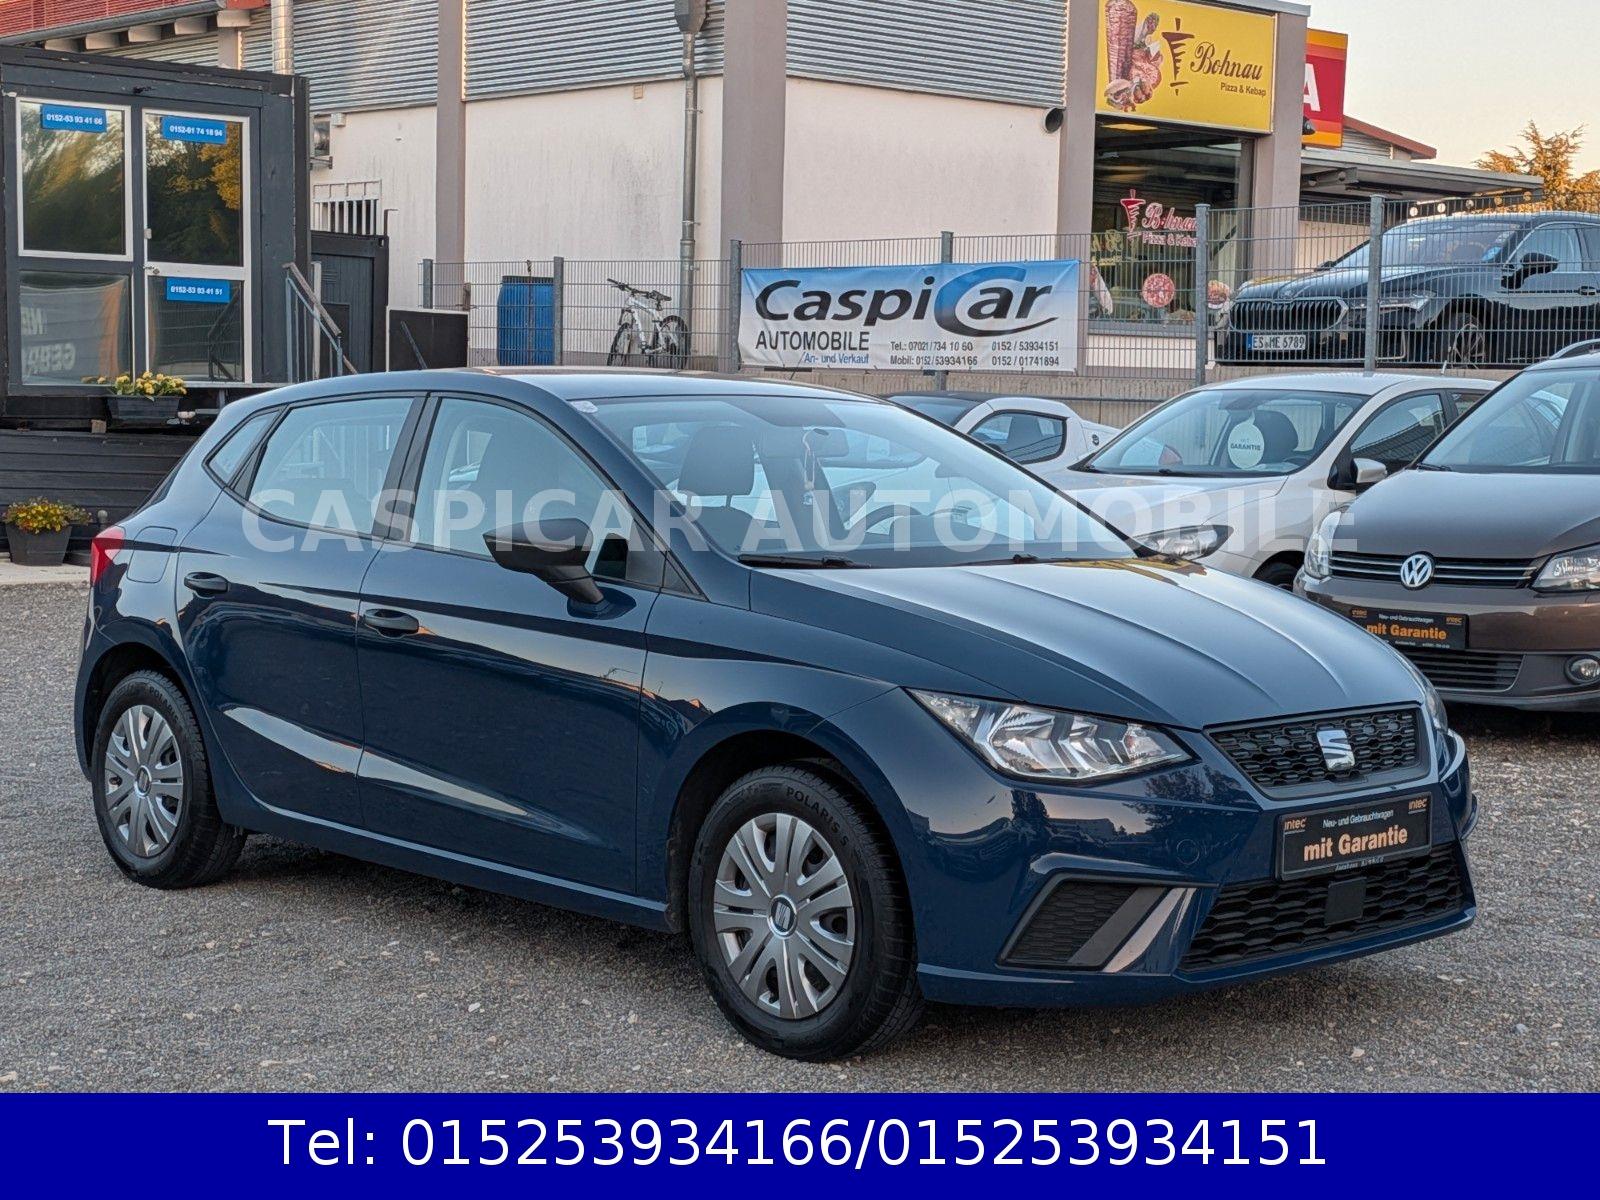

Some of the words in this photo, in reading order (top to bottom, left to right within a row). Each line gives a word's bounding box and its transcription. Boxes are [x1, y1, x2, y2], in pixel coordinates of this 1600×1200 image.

[1190, 41, 1262, 80] Bohnau
[1220, 82, 1238, 93] Pizza
[1239, 85, 1244, 94] &
[1245, 85, 1267, 98] Kebap
[755, 266, 1058, 338] CaspiCar
[756, 330, 870, 351] AUTOMOBILE
[890, 341, 907, 351] Tel.:
[950, 341, 959, 351] 10
[992, 341, 1011, 351] 0152
[1019, 341, 1059, 351] 53934151
[1253, 336, 1264, 349] ES
[804, 353, 819, 363] An-
[821, 353, 836, 363] und
[838, 352, 869, 363] Verkauf
[890, 355, 914, 366] Mobil:
[992, 355, 1011, 366] 0152
[1019, 355, 1059, 366] 01741894
[1366, 622, 1387, 635] mit
[1390, 624, 1448, 640] Garantie
[786, 787, 841, 833] POLARIS
[1322, 819, 1338, 829] Neu-
[1338, 816, 1350, 827] und
[1350, 809, 1394, 825] Gebrauchtwagen
[1303, 836, 1333, 862] mit
[1338, 824, 1408, 855] Garantie
